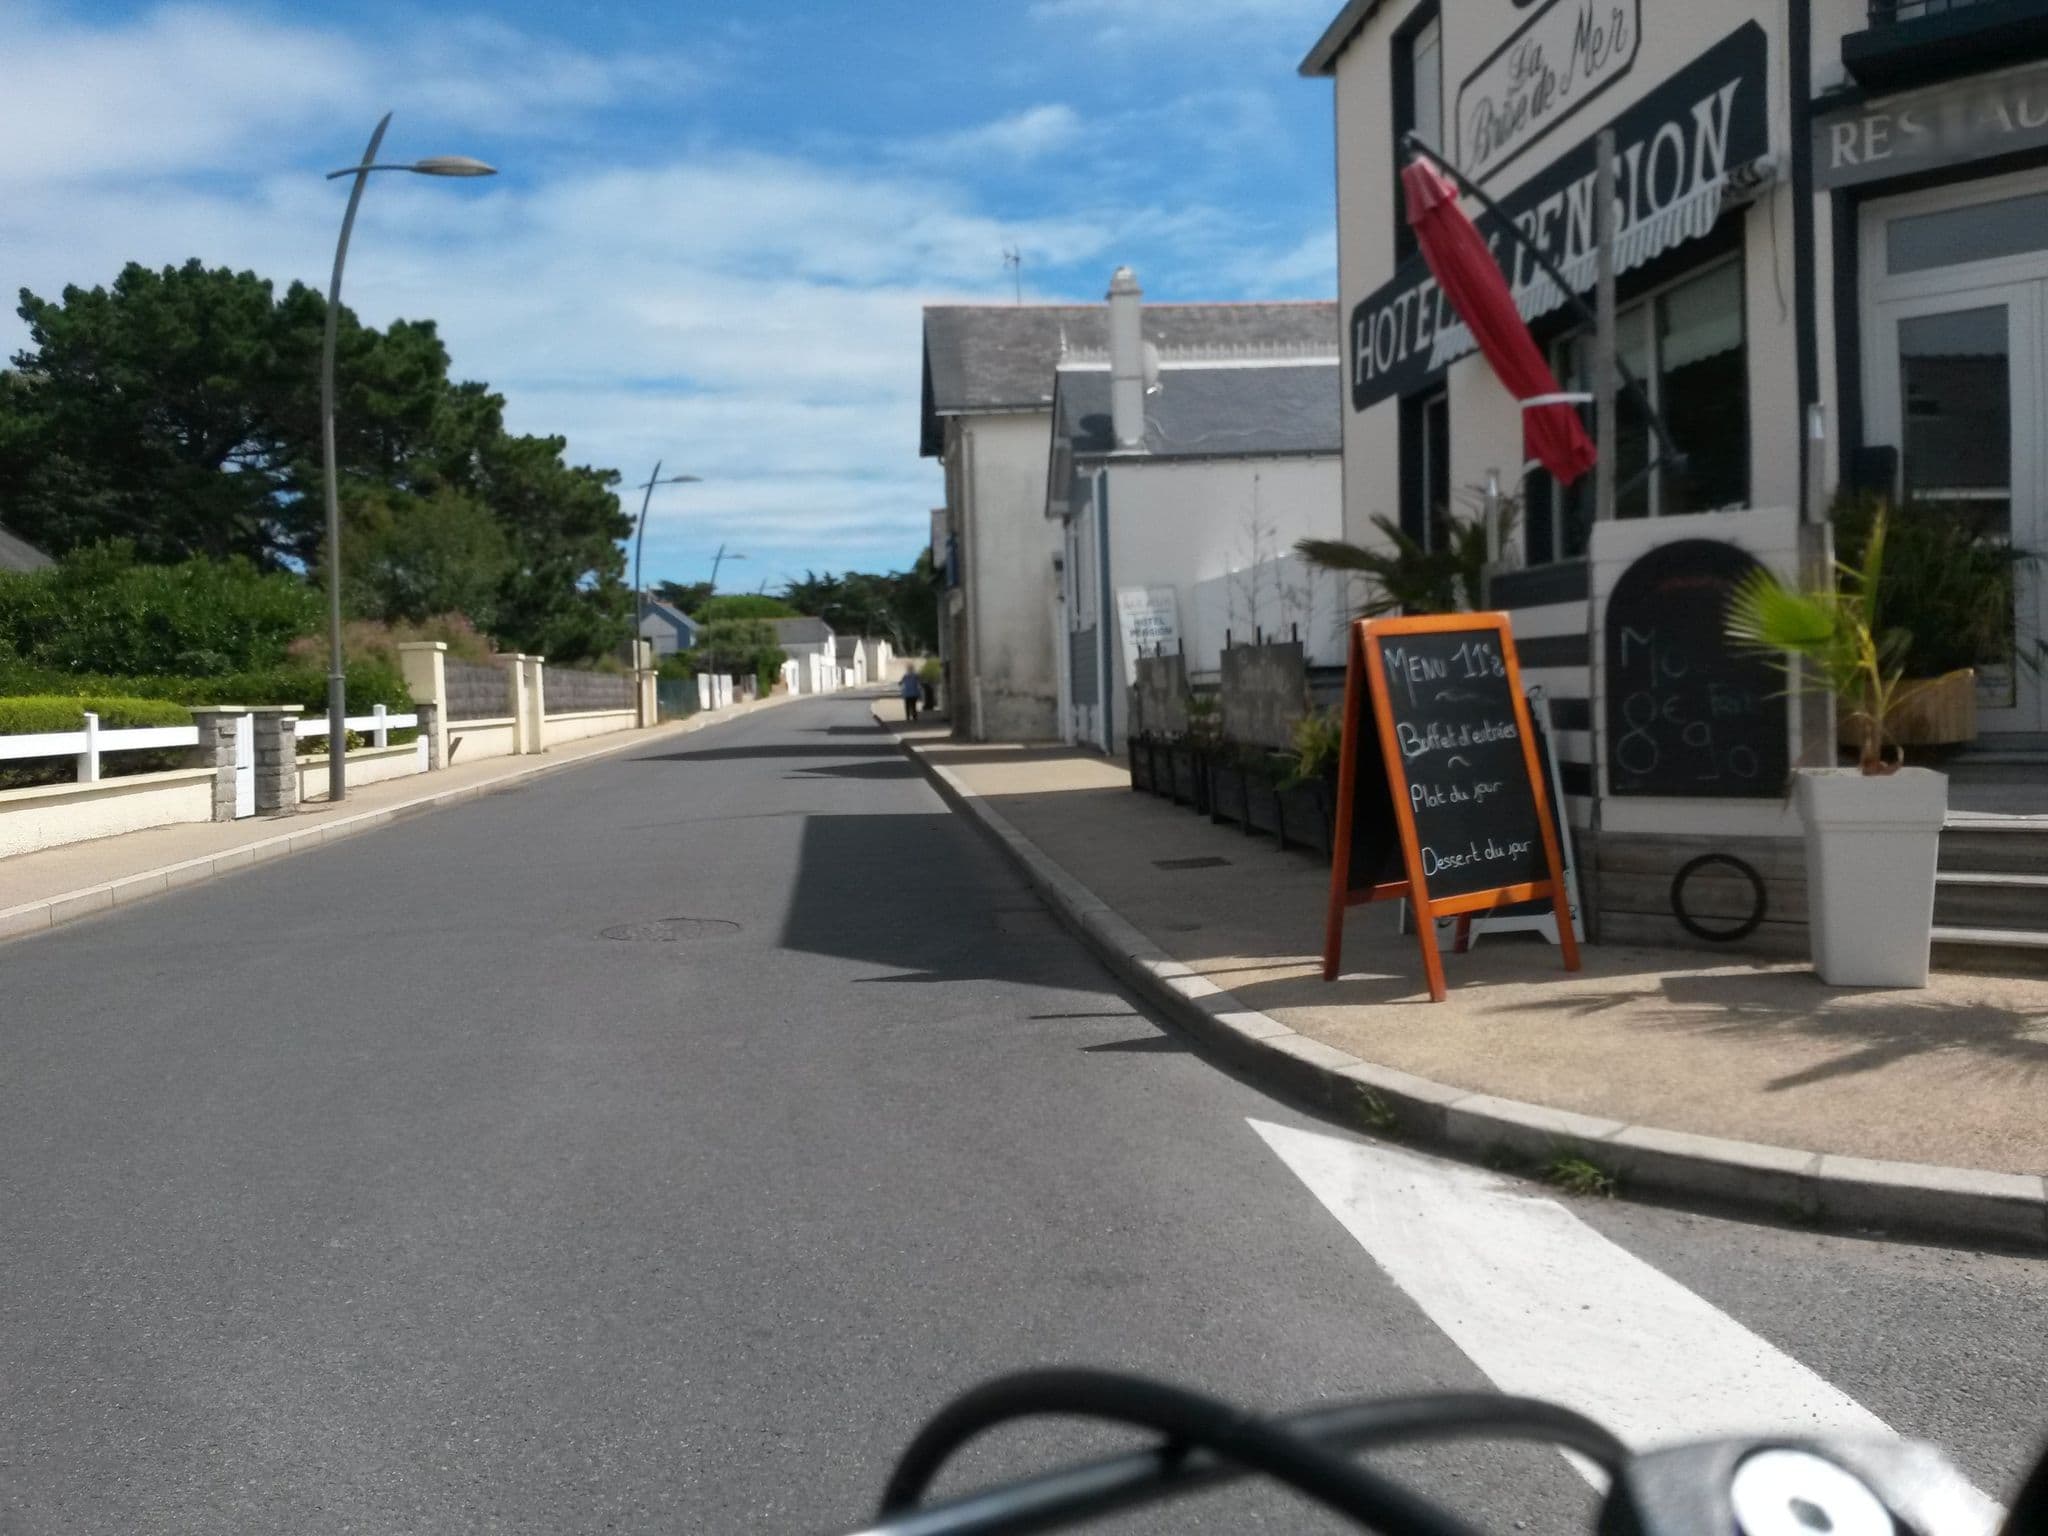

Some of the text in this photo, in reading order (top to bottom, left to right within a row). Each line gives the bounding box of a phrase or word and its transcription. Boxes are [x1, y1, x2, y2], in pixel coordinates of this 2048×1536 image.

[1508, 38, 1543, 96] La
[1559, 0, 1629, 96] Mer
[1355, 276, 1457, 386] HOTEL
[1411, 781, 1503, 813] Plat du jour
[1421, 840, 1482, 876] Dessert
[1484, 838, 1505, 860] du
